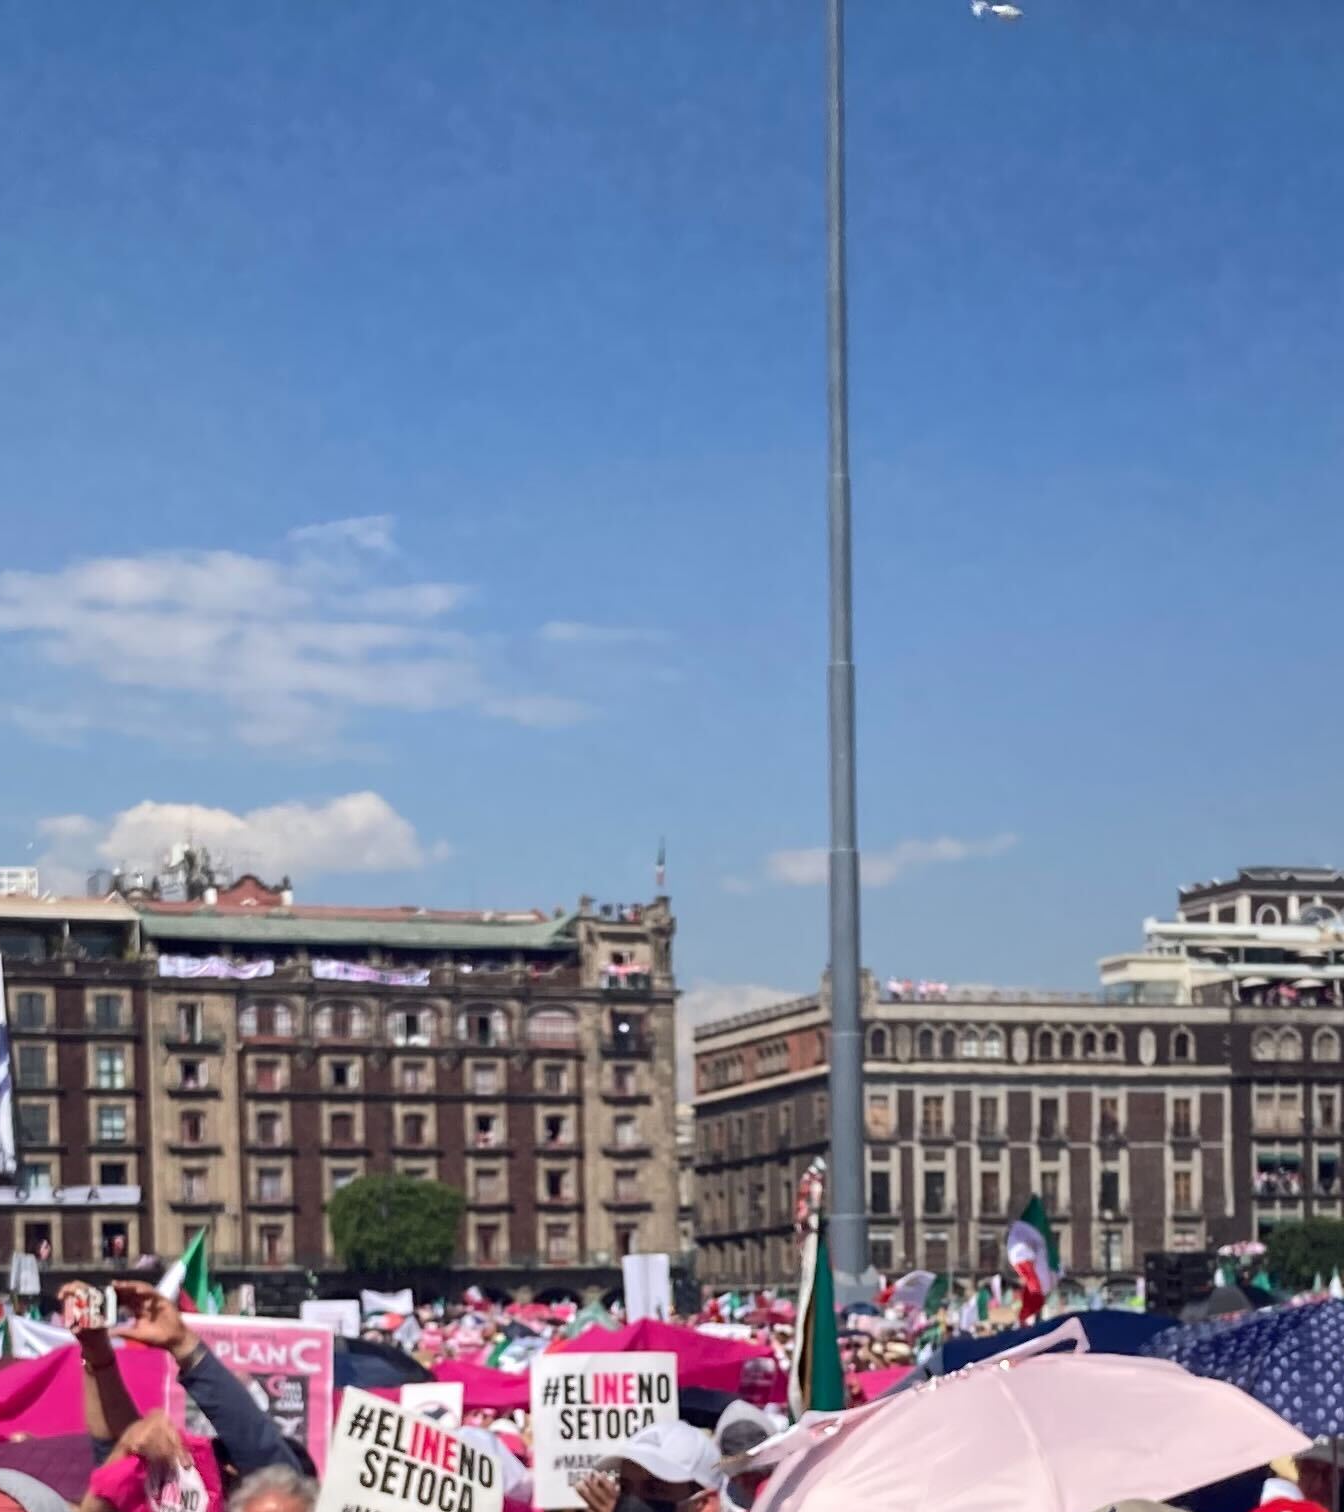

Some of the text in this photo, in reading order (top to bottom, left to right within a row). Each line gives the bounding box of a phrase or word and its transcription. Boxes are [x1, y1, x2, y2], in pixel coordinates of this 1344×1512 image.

[216, 1338, 322, 1374] PLAN C
[543, 1372, 670, 1406] #ELINENO
[348, 1404, 493, 1489] #ELINENO
